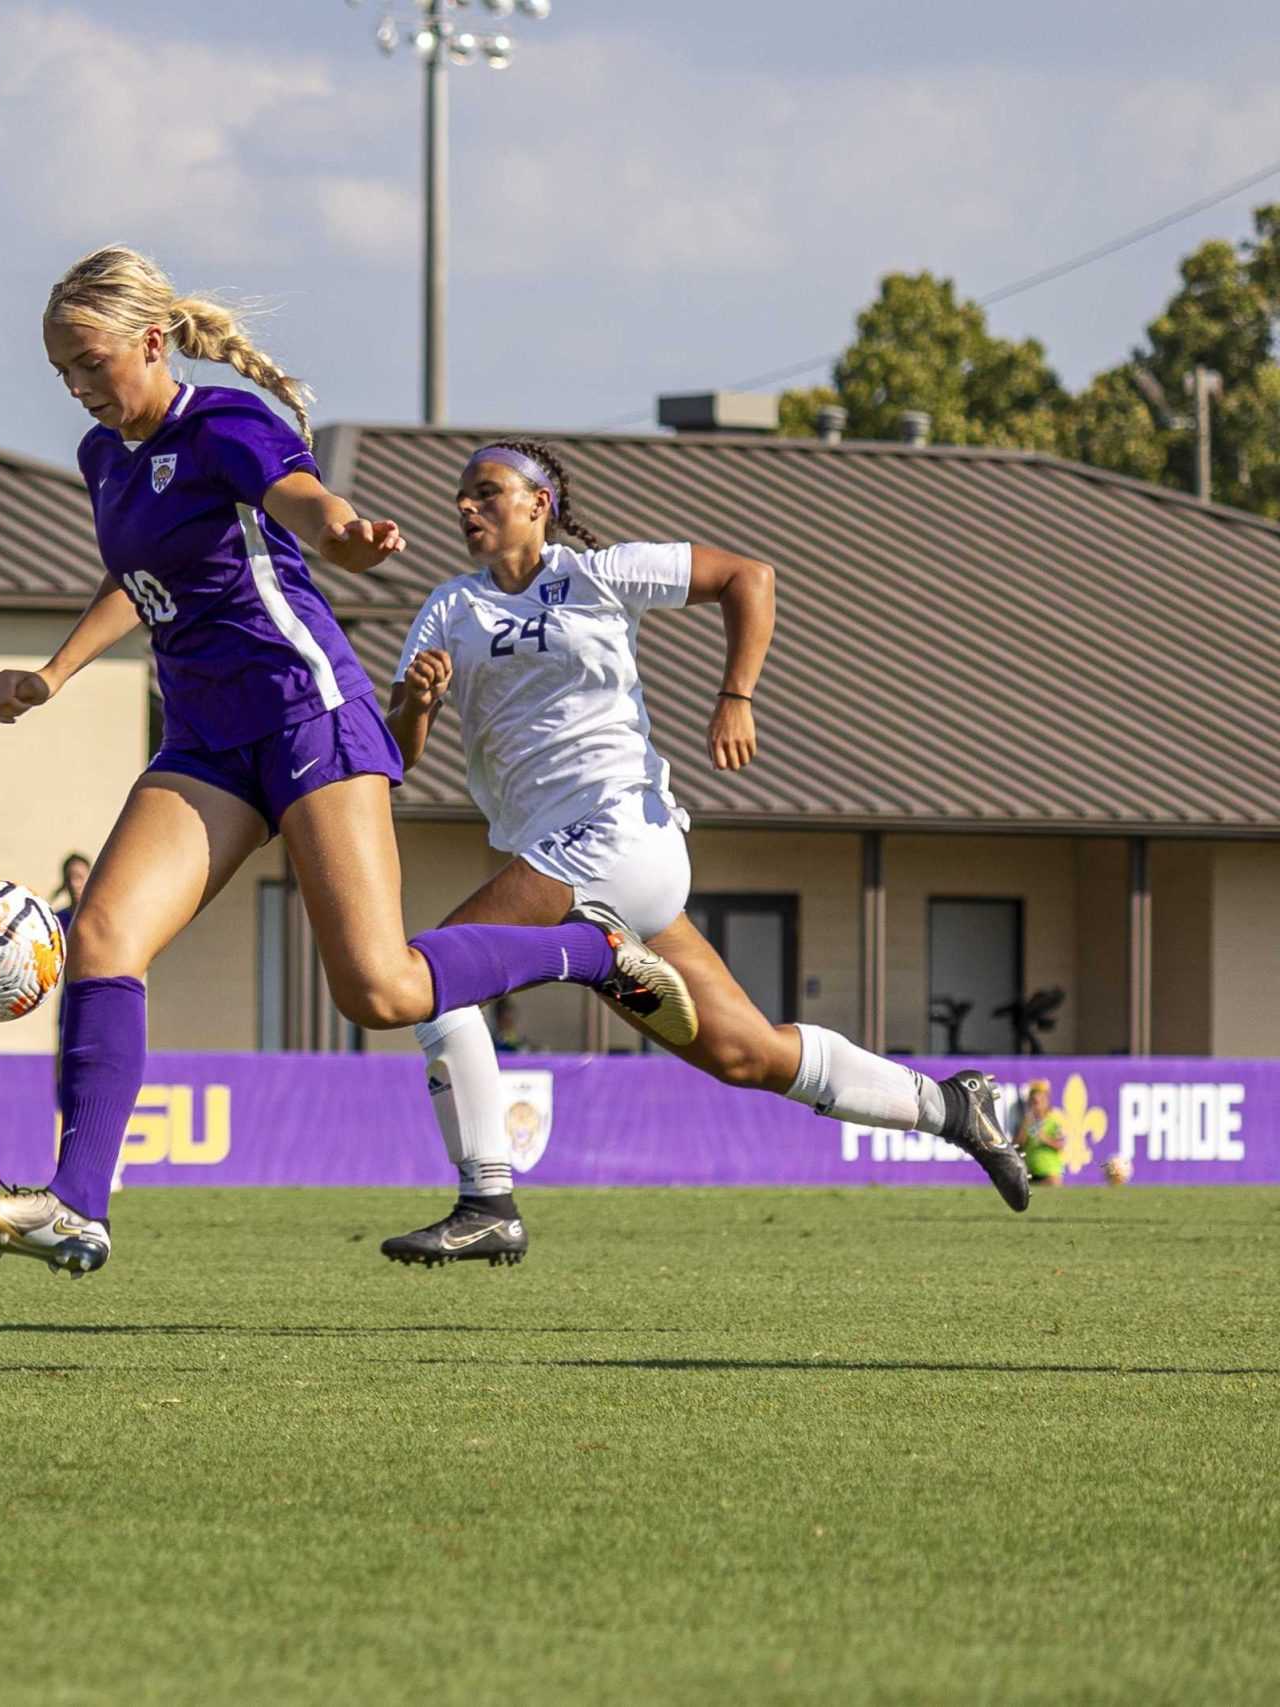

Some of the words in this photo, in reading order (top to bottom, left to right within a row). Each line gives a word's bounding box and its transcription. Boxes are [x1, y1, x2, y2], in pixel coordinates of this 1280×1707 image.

[490, 611, 549, 657] 24
[54, 1083, 232, 1165] SU
[1120, 1083, 1246, 1161] PRIDE
